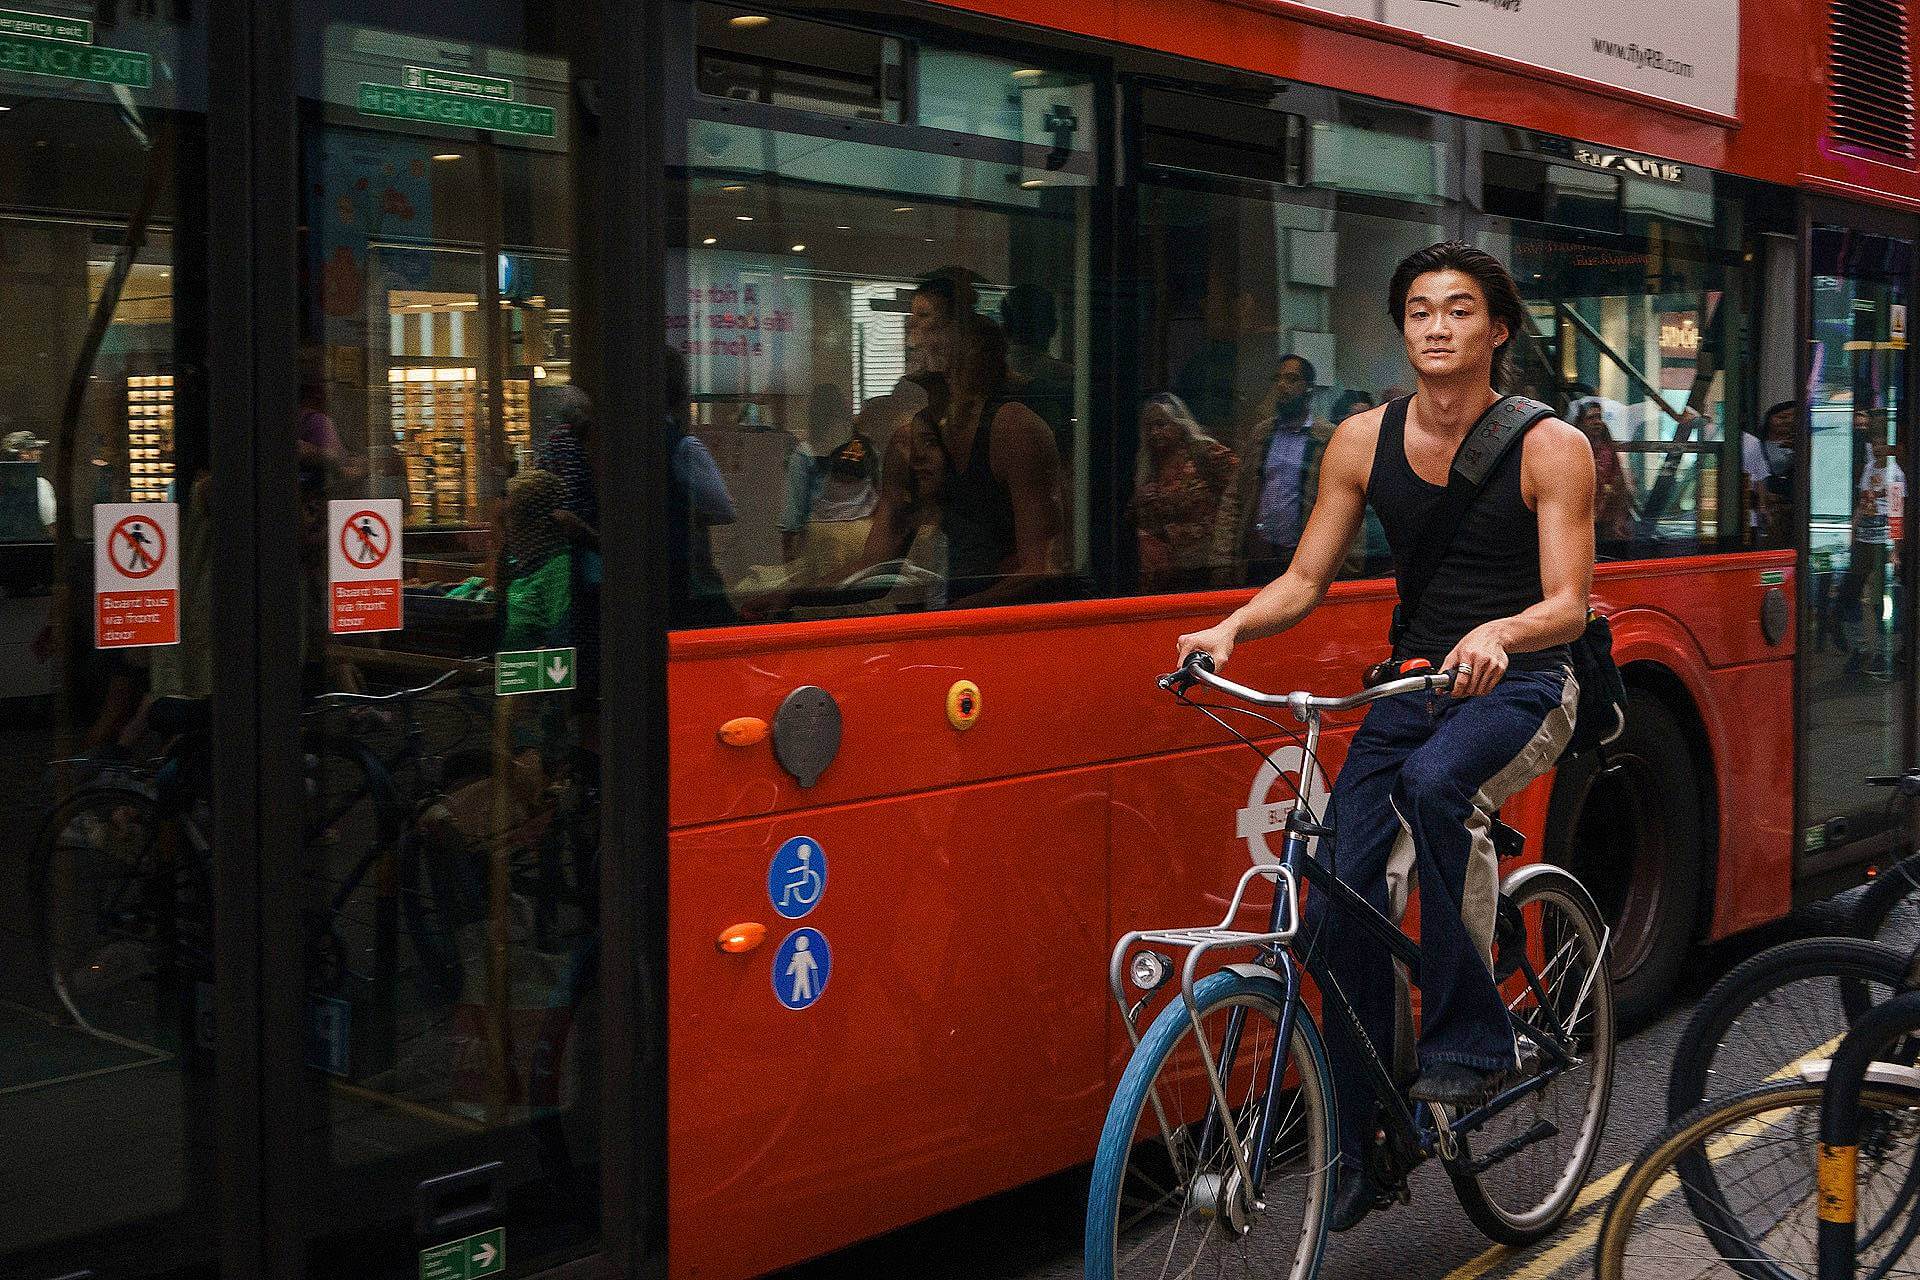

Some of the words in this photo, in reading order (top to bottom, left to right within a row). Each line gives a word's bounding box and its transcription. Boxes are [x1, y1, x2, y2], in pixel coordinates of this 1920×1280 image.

[55, 25, 83, 38] exit
[89, 53, 146, 81] EXIT
[425, 74, 483, 93] Emergency
[485, 84, 506, 96] exit
[382, 91, 508, 126] EMERGENCY
[509, 108, 552, 131] EXIT
[335, 586, 371, 598] Board
[372, 586, 395, 596] bus
[102, 596, 143, 610] Board
[144, 595, 170, 608] bus
[355, 600, 387, 611] front
[125, 612, 161, 625] front
[336, 616, 366, 627] door
[103, 629, 136, 641] door
